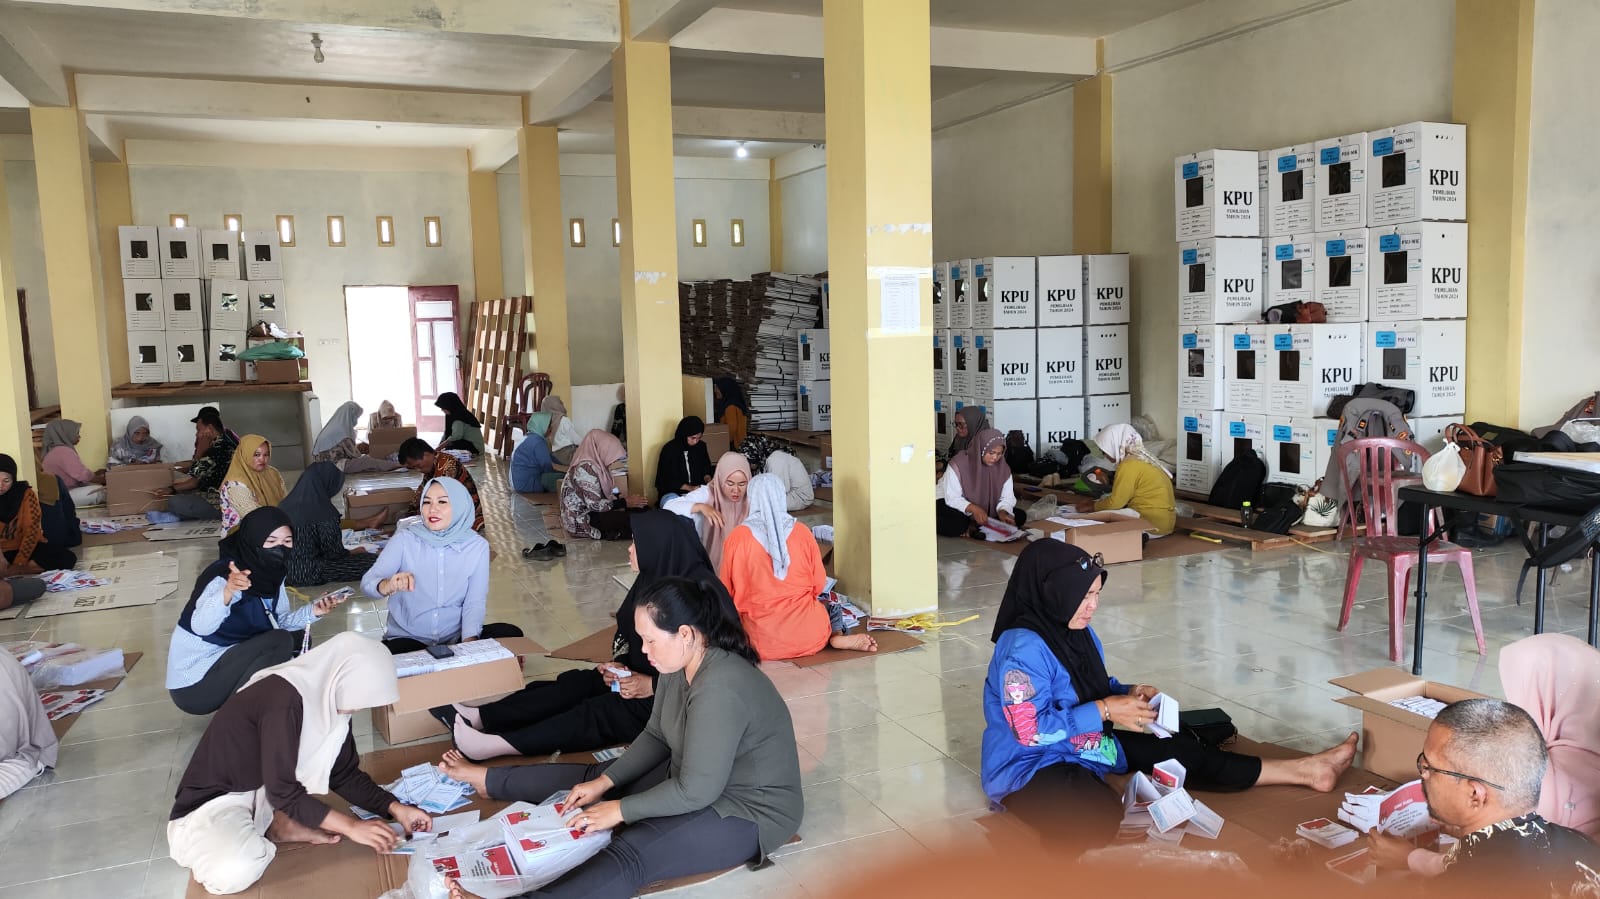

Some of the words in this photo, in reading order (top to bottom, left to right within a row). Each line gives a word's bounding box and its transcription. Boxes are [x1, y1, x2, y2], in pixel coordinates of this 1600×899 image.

[1429, 169, 1459, 187] KPU
[1223, 190, 1253, 206] KPU
[1432, 267, 1461, 284] KPU
[1224, 278, 1254, 293] KPU
[1001, 290, 1029, 303] KPU
[1047, 288, 1076, 302] KPU
[1096, 287, 1124, 300] KPU
[1001, 362, 1029, 376] KPU
[1046, 360, 1076, 374] KPU
[1096, 358, 1122, 371] KPU
[1322, 368, 1352, 384] KPU
[1430, 366, 1458, 382] KPU
[818, 404, 830, 414] KP
[1048, 430, 1077, 443] KPU
